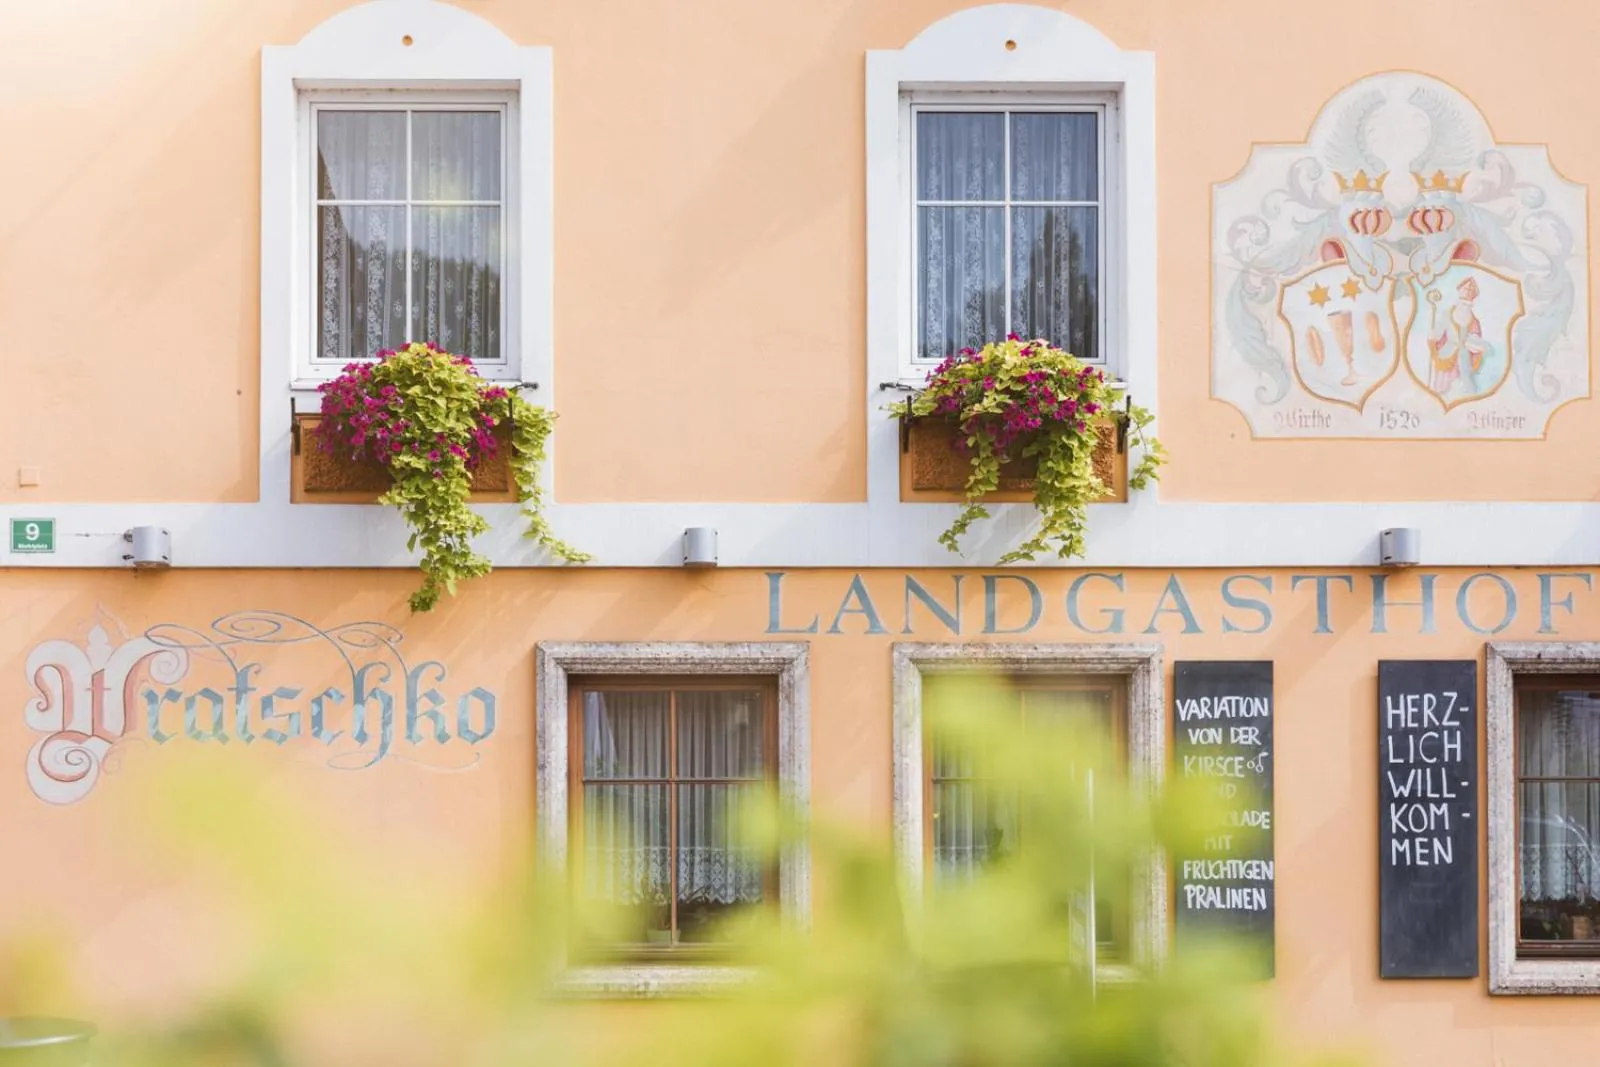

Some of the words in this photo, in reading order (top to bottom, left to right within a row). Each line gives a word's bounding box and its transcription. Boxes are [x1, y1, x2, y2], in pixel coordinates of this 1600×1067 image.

[25, 522, 40, 541] 9
[765, 572, 1592, 635] LANDGASTHOF
[24, 610, 497, 804] Wratschko
[1176, 695, 1269, 721] VARIATION
[1386, 692, 1469, 729] HERZ-
[1187, 727, 1223, 744] VON
[1230, 726, 1262, 745] DER
[1387, 730, 1462, 763] LICH
[1183, 755, 1245, 777] KIRSCE
[1391, 836, 1453, 866] MEN
[1183, 884, 1267, 911] PRALINEN
